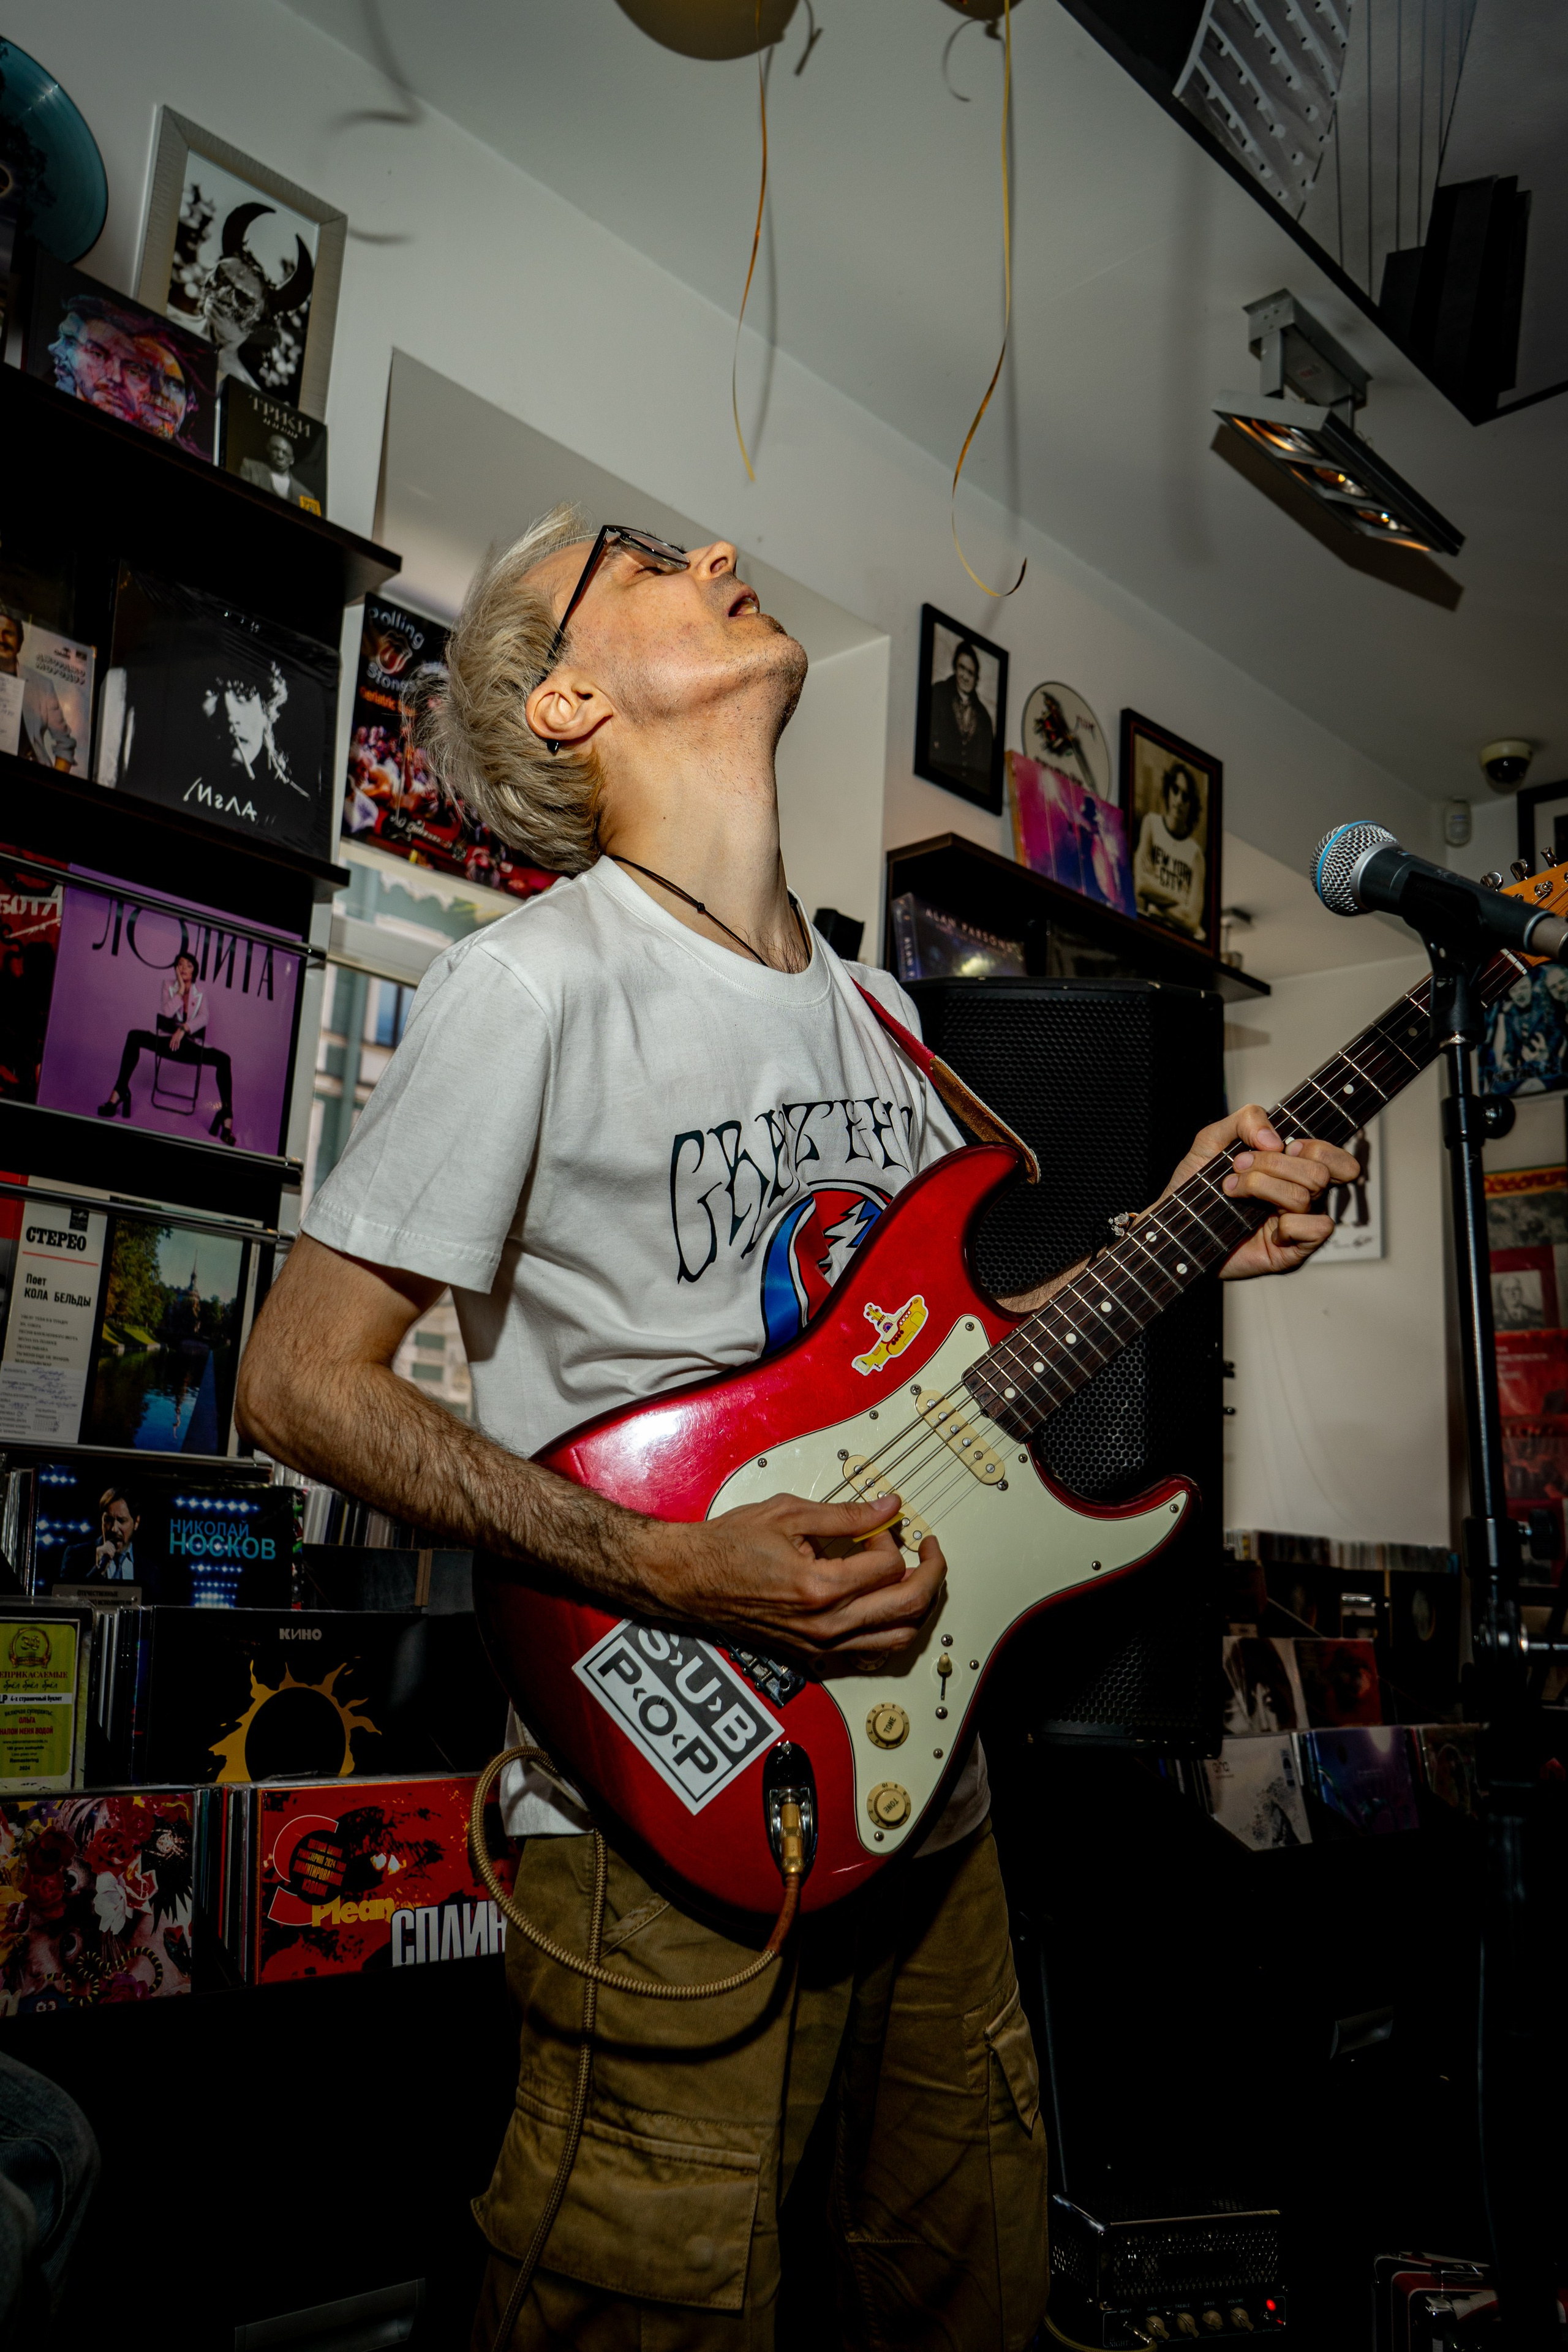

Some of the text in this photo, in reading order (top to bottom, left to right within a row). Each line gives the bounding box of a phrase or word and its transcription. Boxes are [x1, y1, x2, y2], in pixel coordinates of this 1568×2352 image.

[92, 897, 274, 1001] ЛОЛИТА
[26, 1226, 86, 1251] СТЕРЕО
[26, 1273, 47, 1286] Поет
[24, 1287, 91, 1307] КОЛА БЕЛЬДЫ
[170, 1519, 249, 1537] НИКОЛАЙ
[169, 1532, 276, 1561] НОСКОВ
[279, 1628, 322, 1640] КИНО
[36, 1726, 53, 1735] ВОДОЙ
[883, 1716, 896, 1733] TONE
[883, 1797, 899, 1814] TONE
[324, 1856, 336, 1869] 2024
[391, 1900, 508, 1967] СПЛИН
